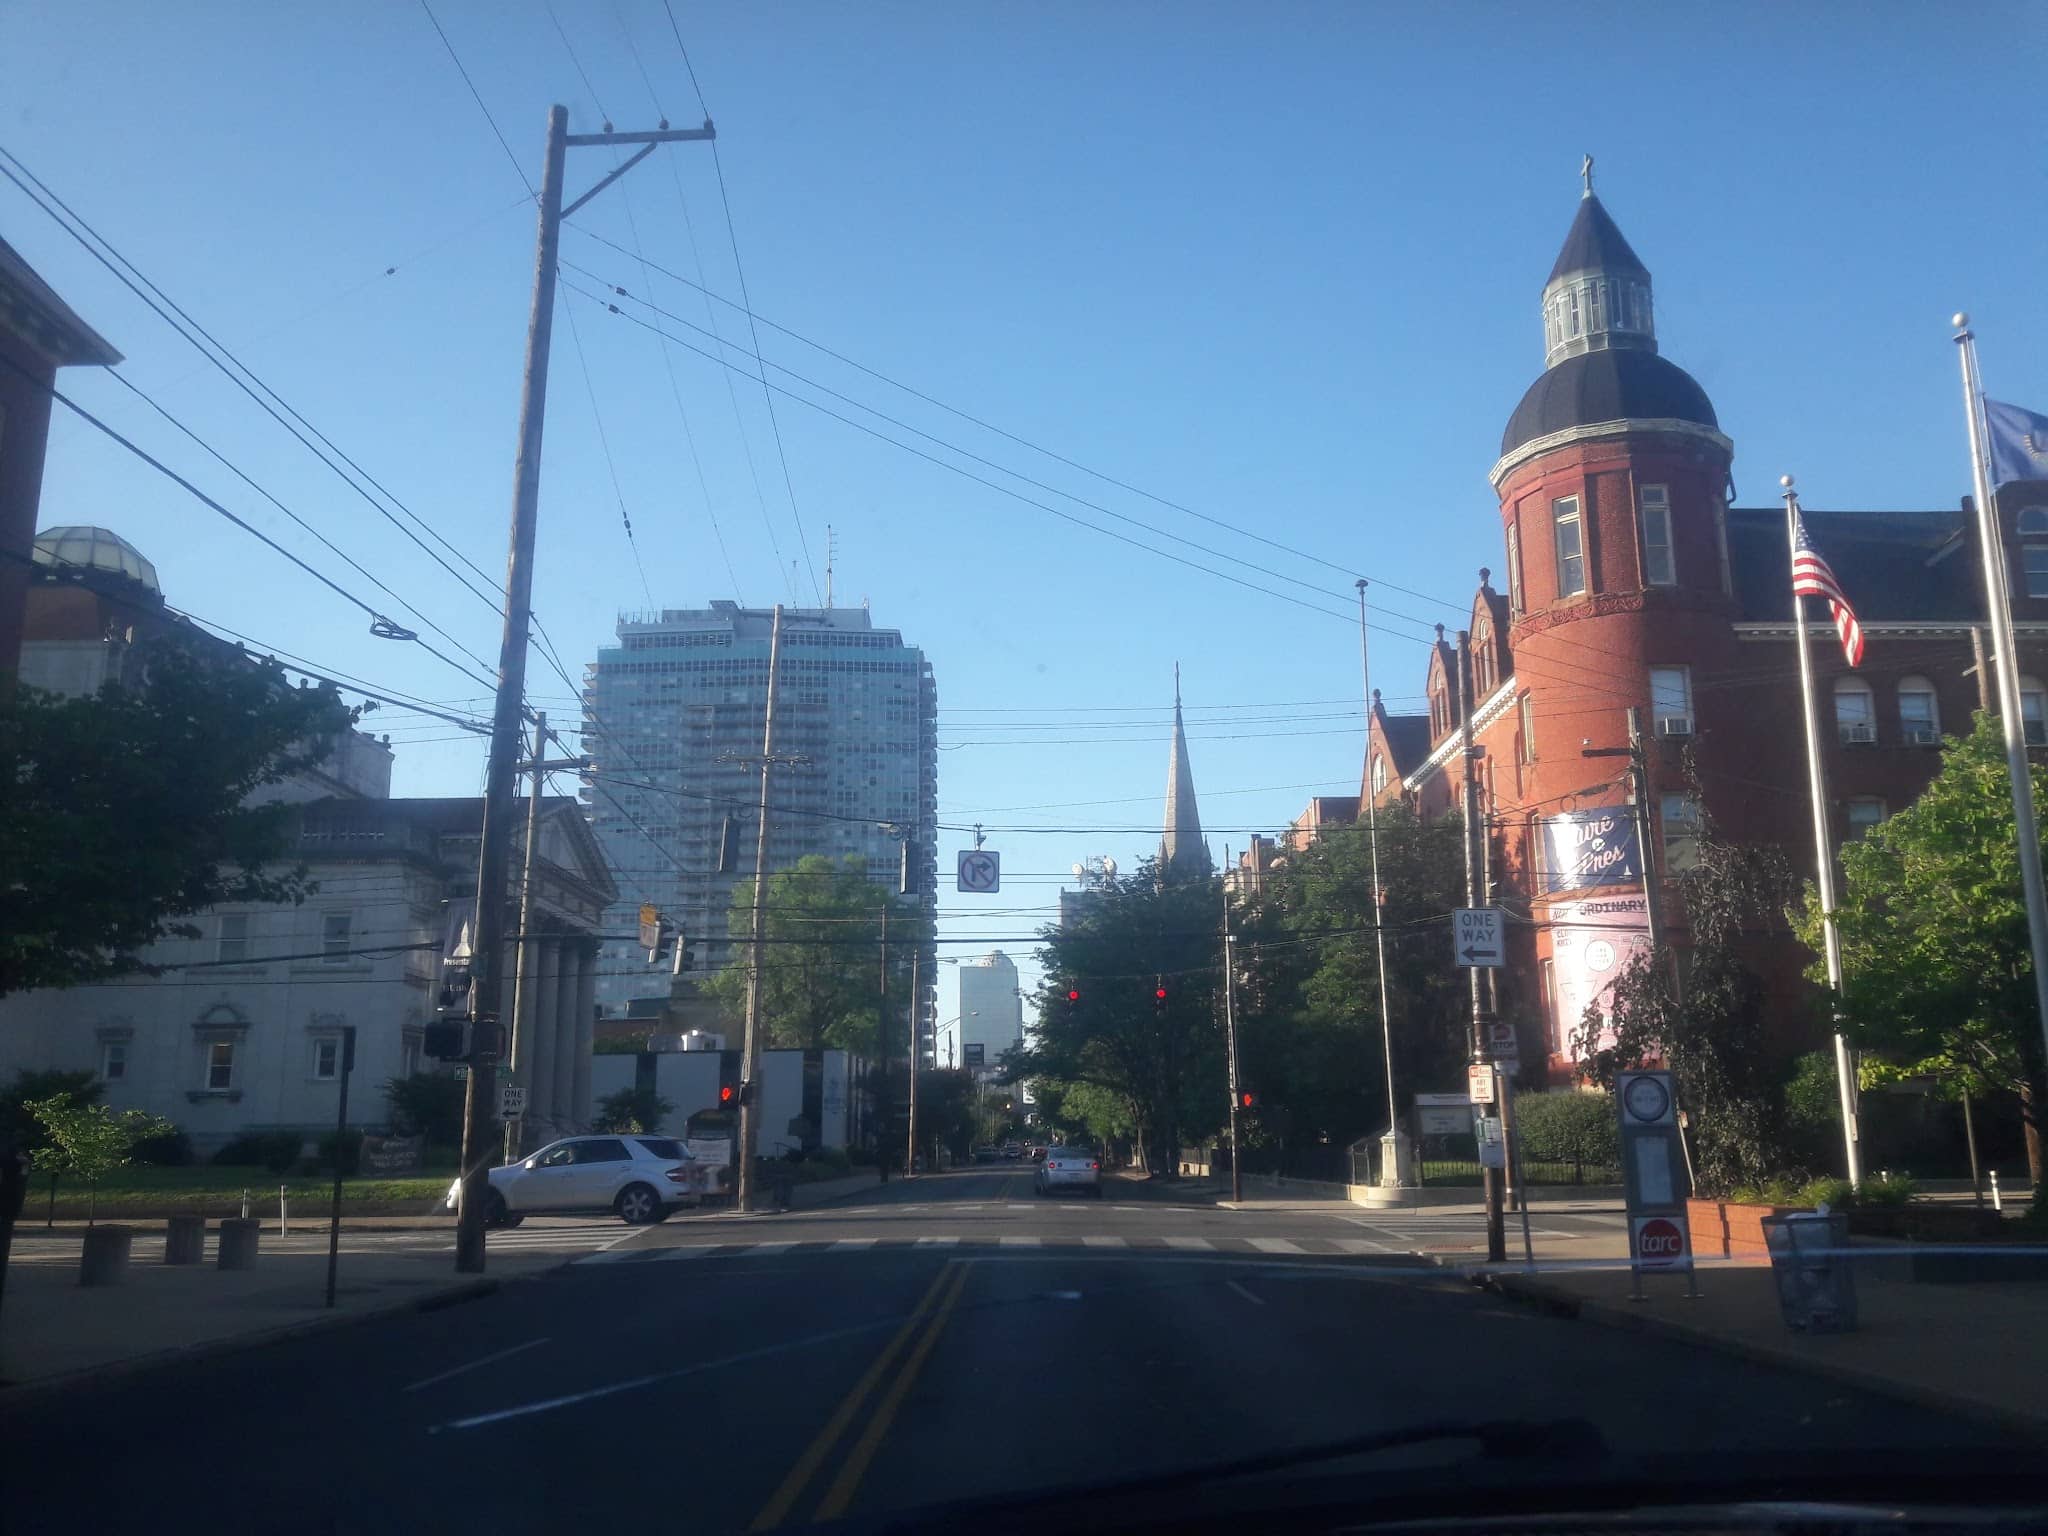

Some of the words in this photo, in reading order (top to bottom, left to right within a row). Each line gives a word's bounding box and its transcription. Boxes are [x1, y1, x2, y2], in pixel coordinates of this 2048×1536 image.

[1462, 913, 1497, 927] ONE
[1462, 928, 1496, 942] WAY
[504, 1089, 522, 1098] ONE
[503, 1098, 522, 1107] WAY
[1641, 1233, 1680, 1253] tarc
